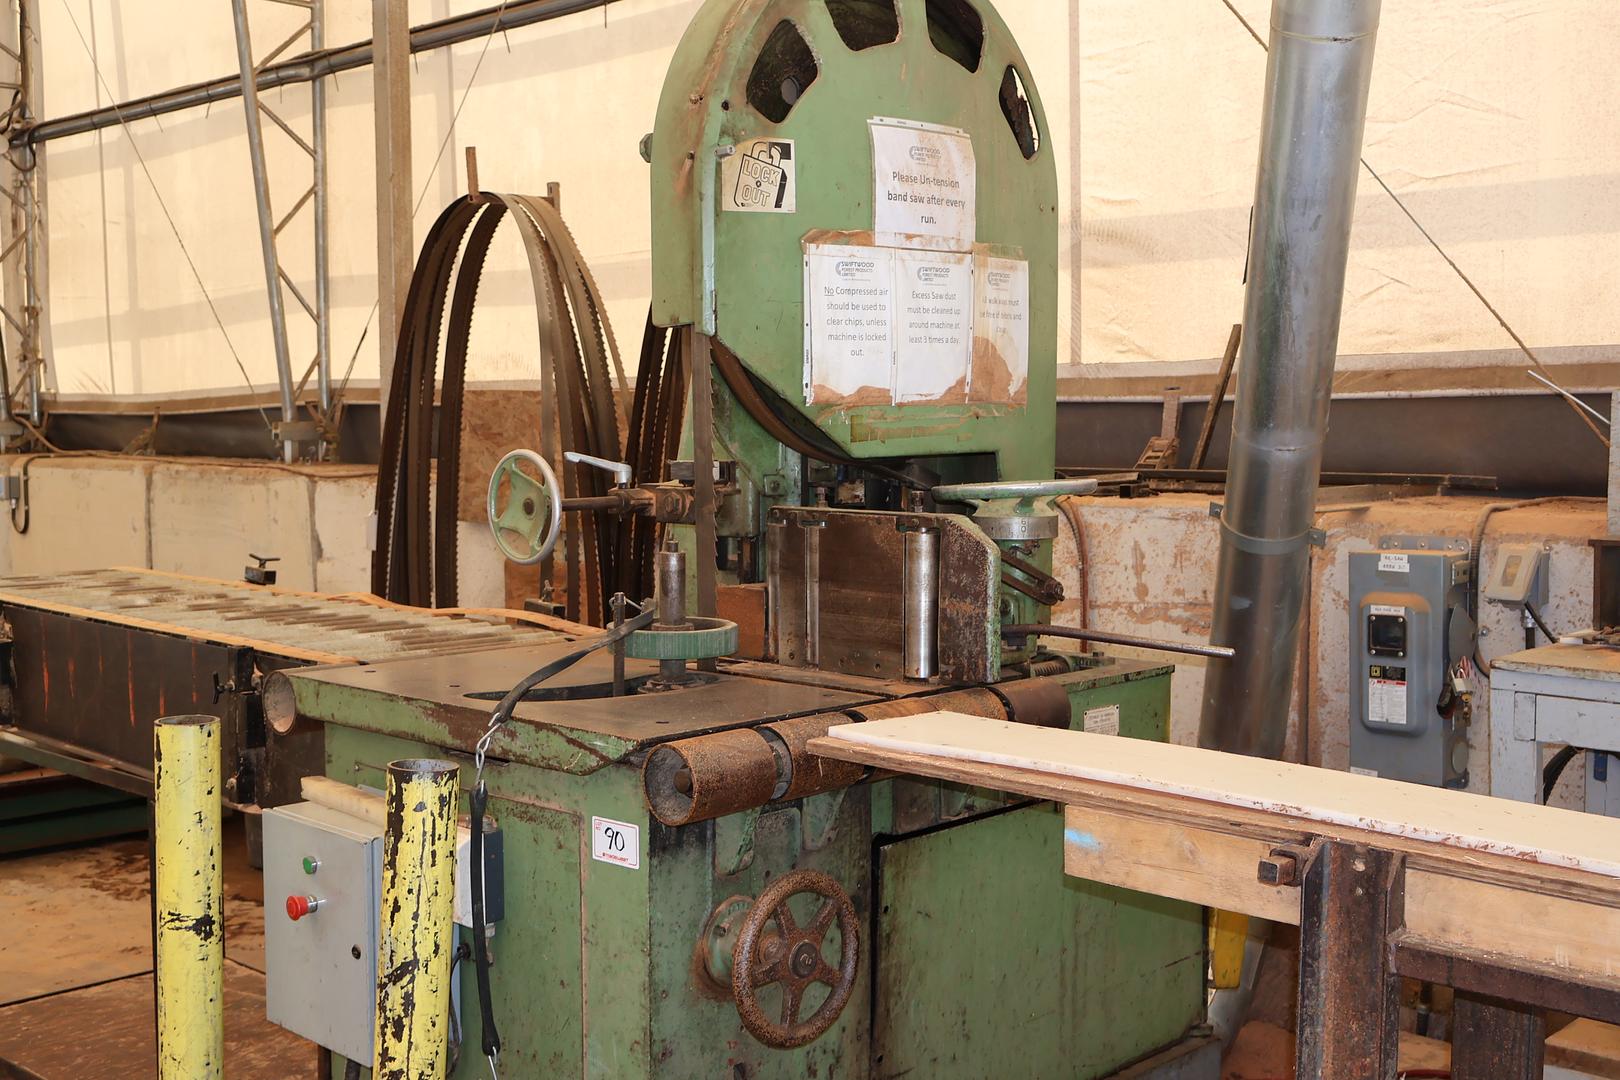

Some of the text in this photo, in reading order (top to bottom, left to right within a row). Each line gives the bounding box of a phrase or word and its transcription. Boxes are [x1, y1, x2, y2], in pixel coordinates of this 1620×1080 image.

[742, 160, 780, 187] LOCK
[892, 171, 960, 188] Please Un-tension
[742, 184, 770, 207] OUT
[888, 190, 966, 209] band saw after every
[920, 215, 937, 224] run.
[824, 286, 834, 296] No
[836, 286, 878, 296] Compressed
[912, 290, 930, 299] Excess
[932, 292, 943, 300] Saw
[932, 306, 952, 314] cleaned
[827, 318, 842, 326] clear
[845, 318, 864, 327] chips,
[828, 333, 856, 341] machine
[950, 336, 960, 344] day.
[605, 827, 625, 851] 90
